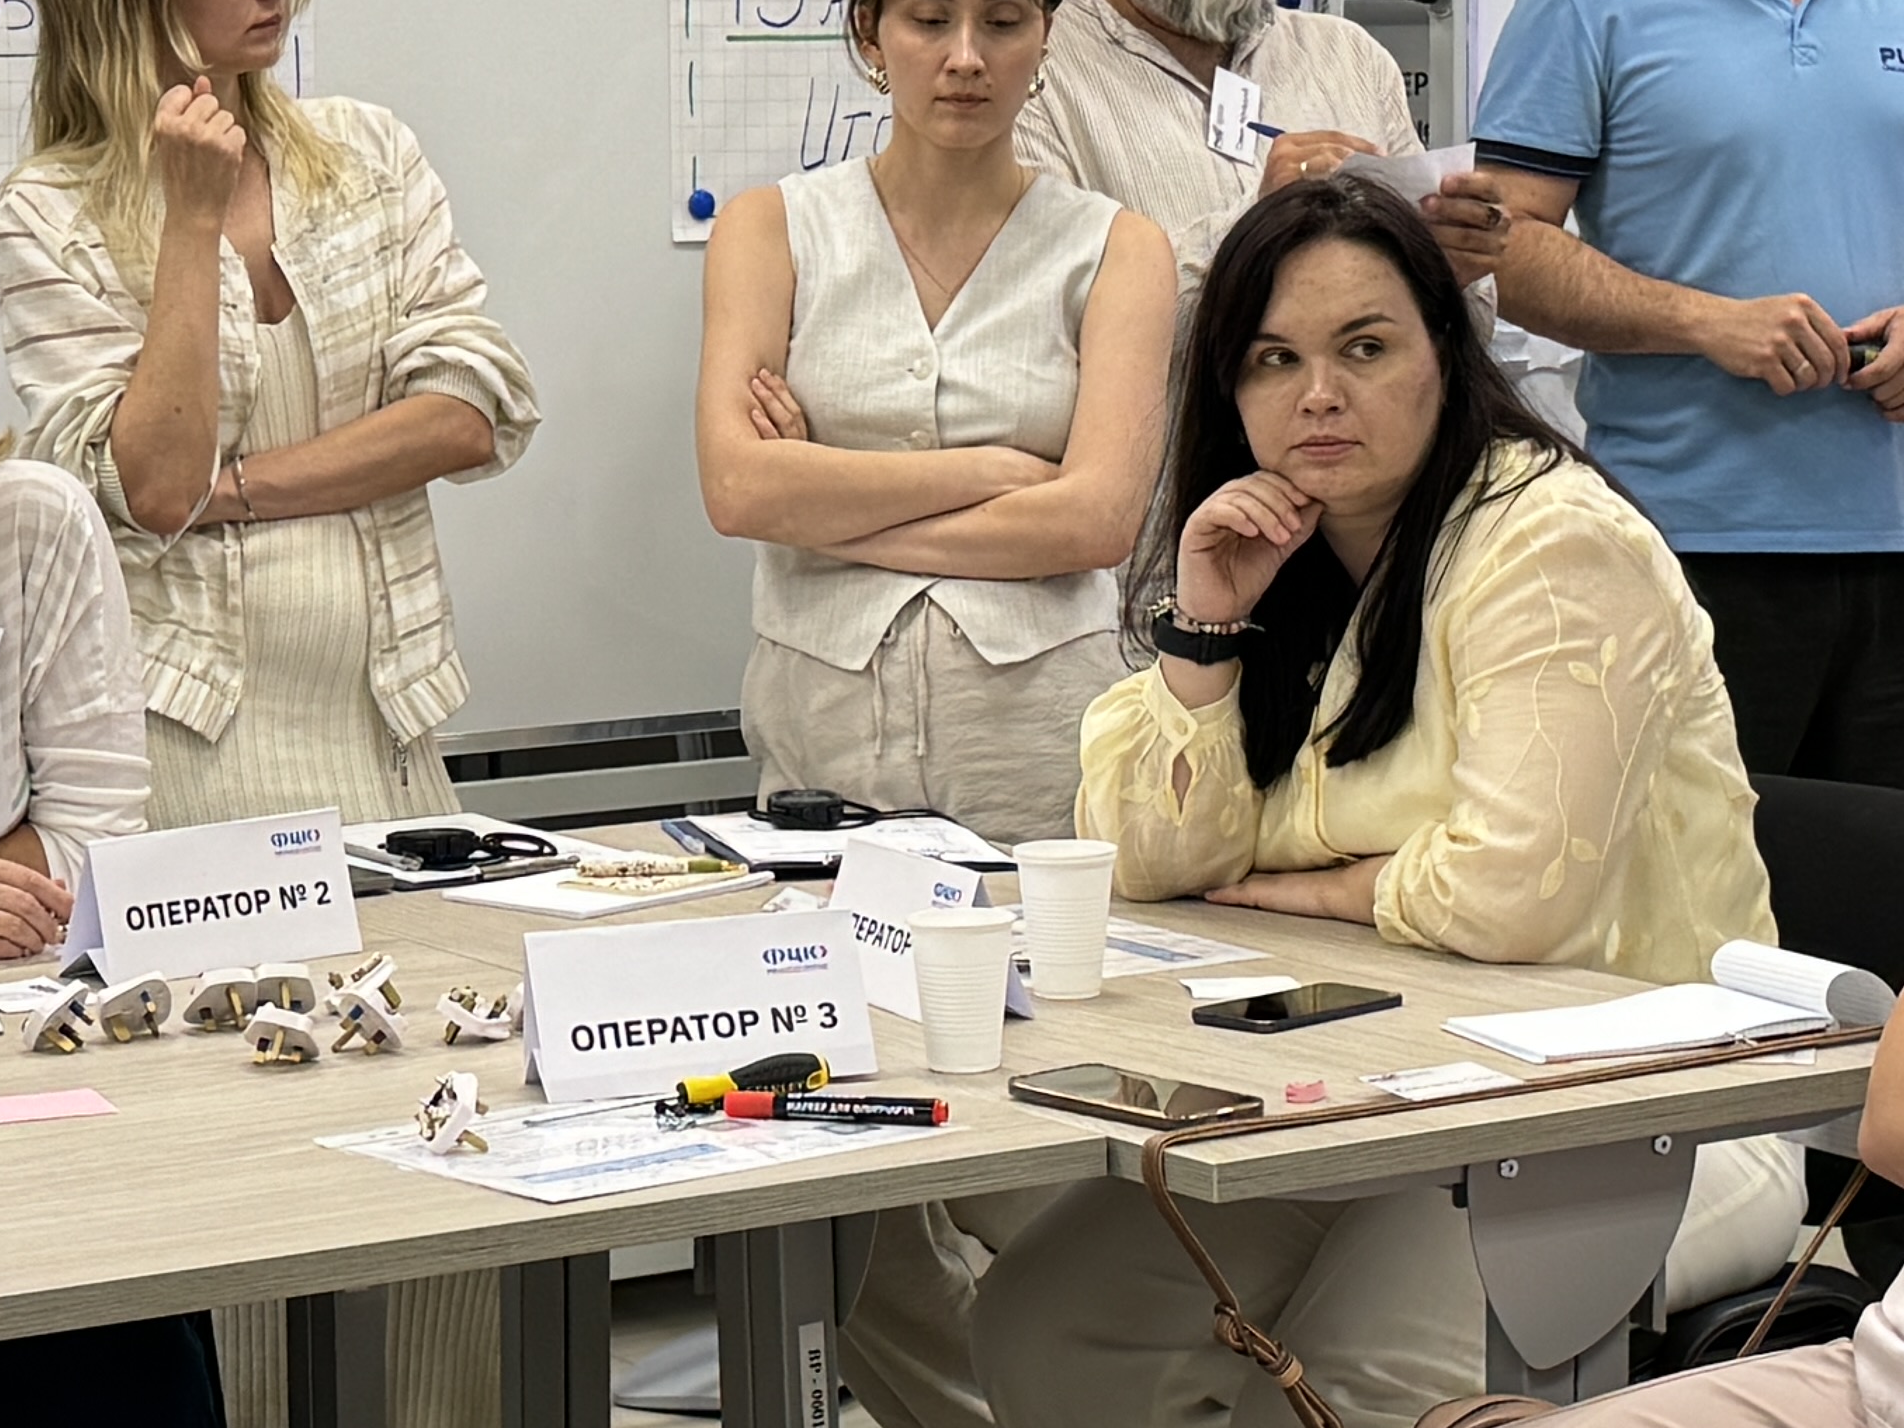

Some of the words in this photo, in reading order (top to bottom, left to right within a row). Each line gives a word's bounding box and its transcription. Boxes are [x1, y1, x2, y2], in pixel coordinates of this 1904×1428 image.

[800, 76, 894, 172] Ито
[125, 888, 272, 932] ОПЕРАТОР
[278, 883, 308, 911] №
[313, 880, 332, 906] 2
[851, 911, 913, 956] ЕРАТОР
[570, 1008, 760, 1052] ОПЕРАТОР
[770, 1004, 808, 1034] №
[817, 1001, 839, 1030] 3
